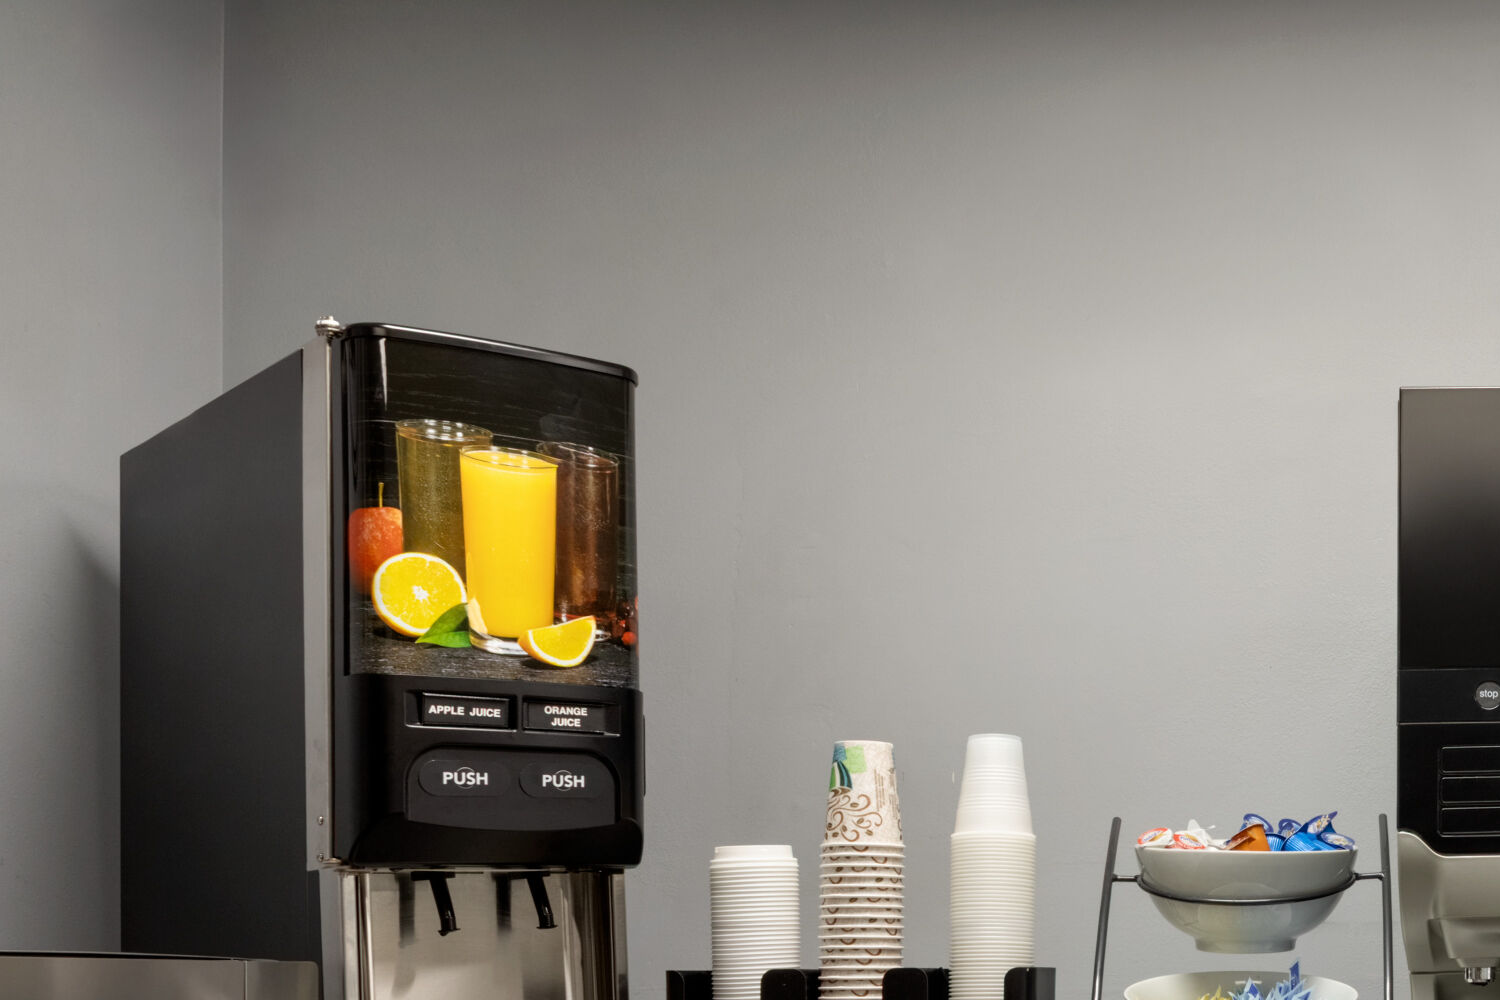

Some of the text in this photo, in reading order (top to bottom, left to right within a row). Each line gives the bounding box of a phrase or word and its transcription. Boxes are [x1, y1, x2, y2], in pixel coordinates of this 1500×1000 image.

[1479, 689, 1499, 700] stop
[428, 705, 501, 718] APPLE JUICE
[544, 705, 588, 717] ORANGE
[551, 717, 581, 727] JUICE
[442, 772, 489, 786] PUSH
[542, 774, 585, 788] PUSH
